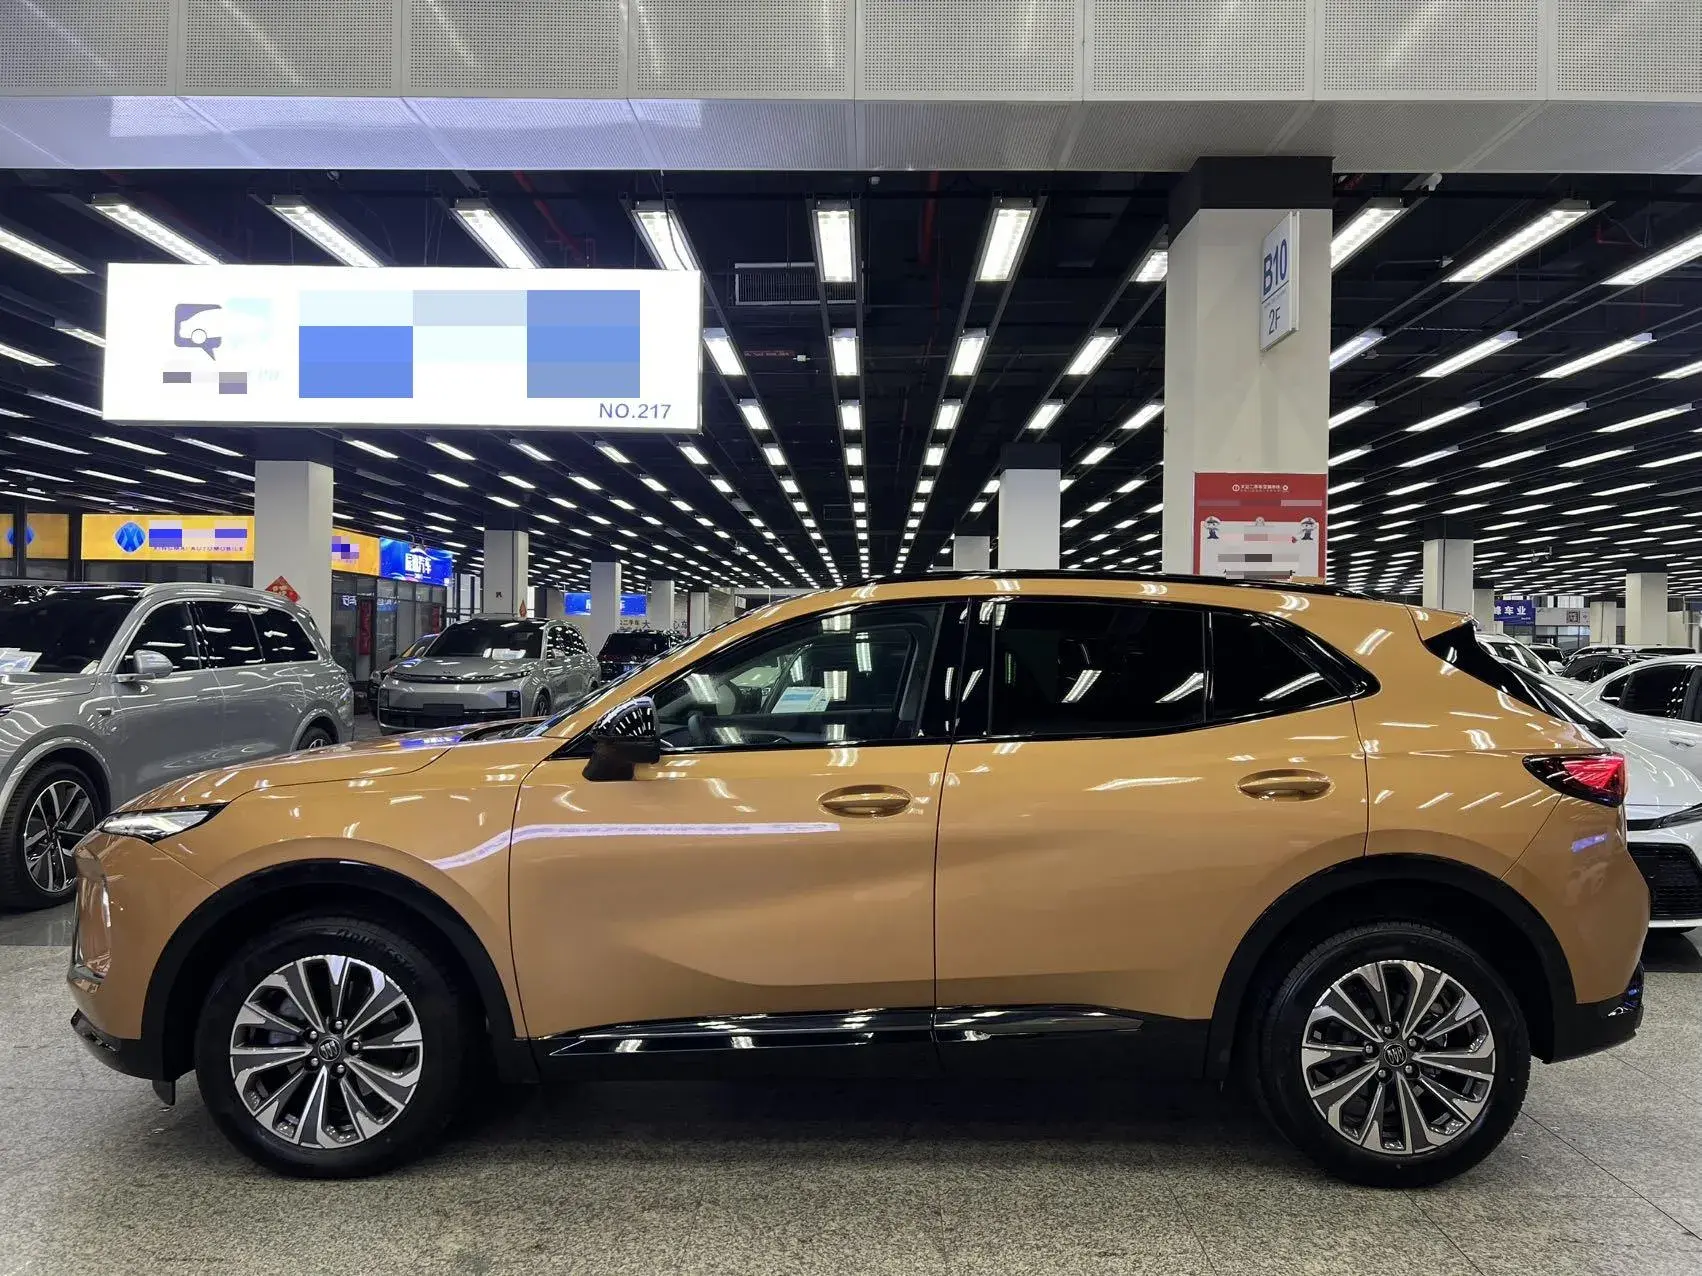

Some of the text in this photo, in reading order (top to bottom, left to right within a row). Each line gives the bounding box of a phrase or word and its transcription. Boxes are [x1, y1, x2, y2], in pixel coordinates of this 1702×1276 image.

[1264, 239, 1287, 296] B10
[1269, 306, 1281, 335] 2F
[599, 402, 672, 419] NO.217
